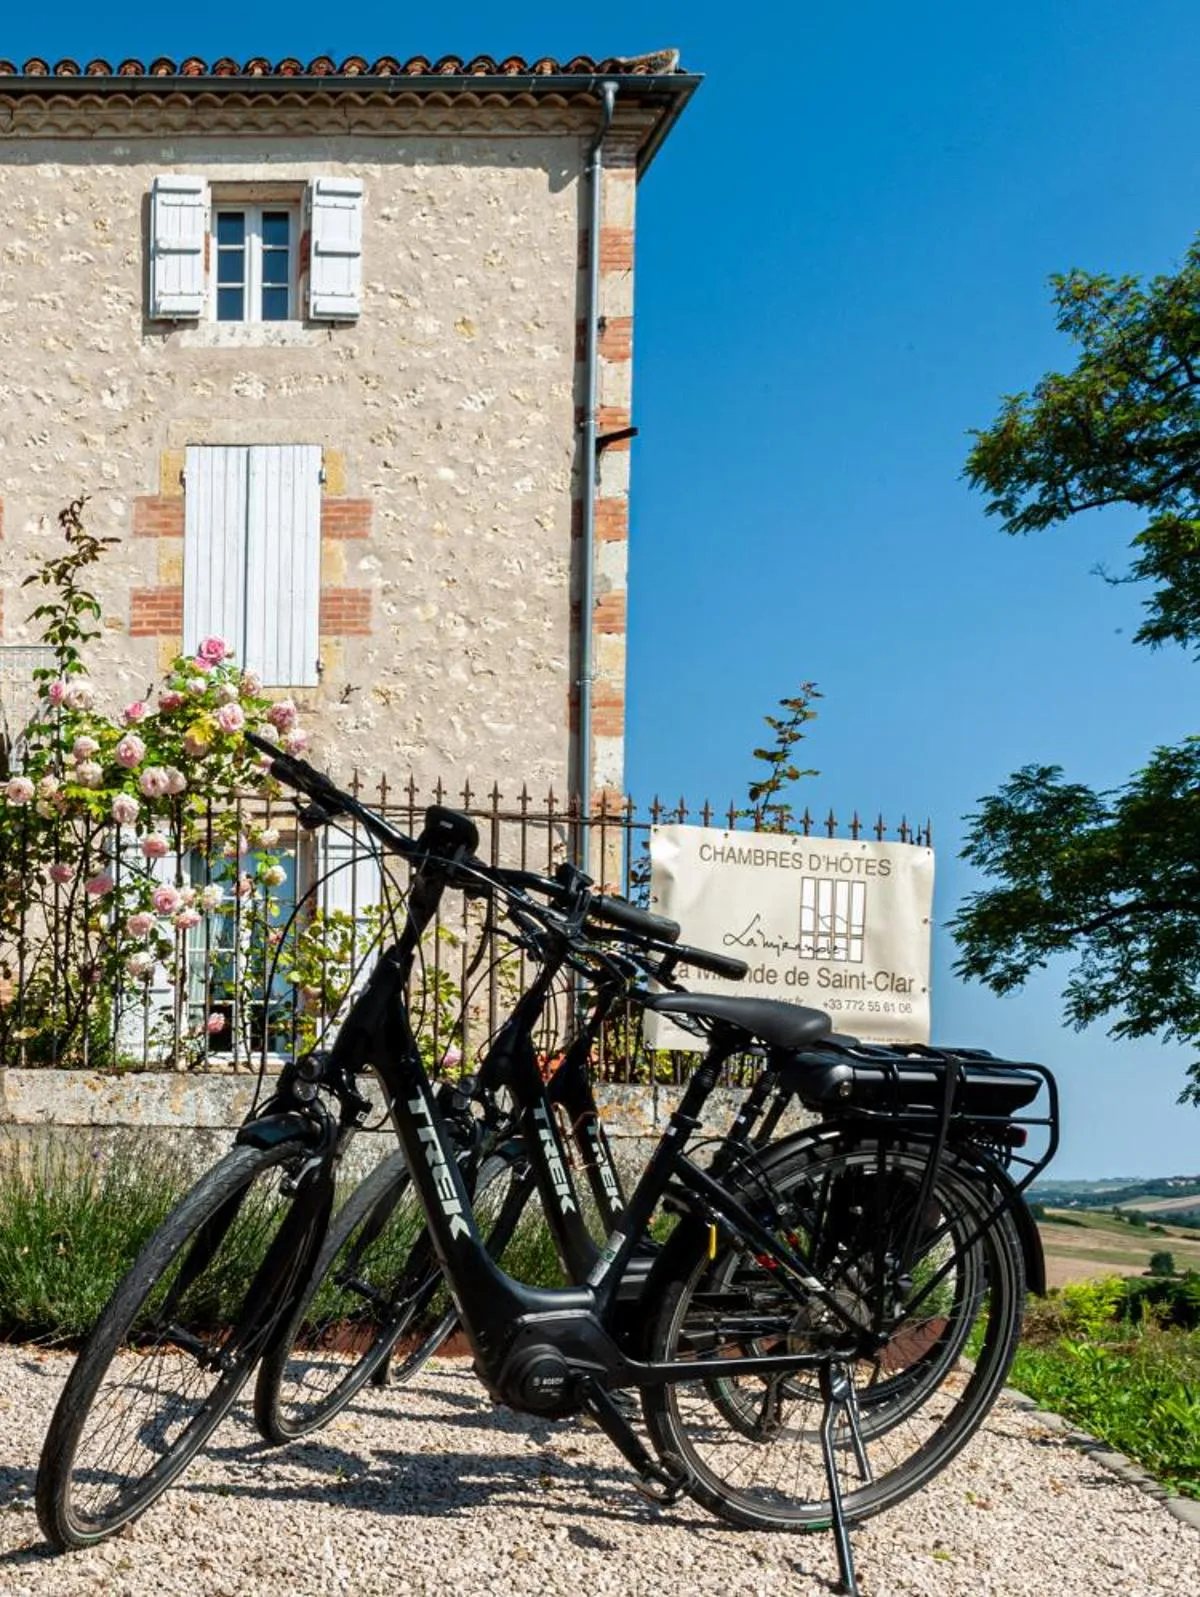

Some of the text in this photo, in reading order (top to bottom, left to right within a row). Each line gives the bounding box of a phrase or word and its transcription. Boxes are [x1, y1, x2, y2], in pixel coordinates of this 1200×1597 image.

[699, 844, 892, 877] CHAMBRES D'HÔTES
[785, 966, 810, 987] de
[816, 967, 916, 993] Saint-Clar
[823, 998, 842, 1010] +33
[844, 999, 865, 1011] 772
[867, 1001, 881, 1012] 55
[408, 1084, 472, 1241] TREK
[533, 1097, 577, 1215] TREK
